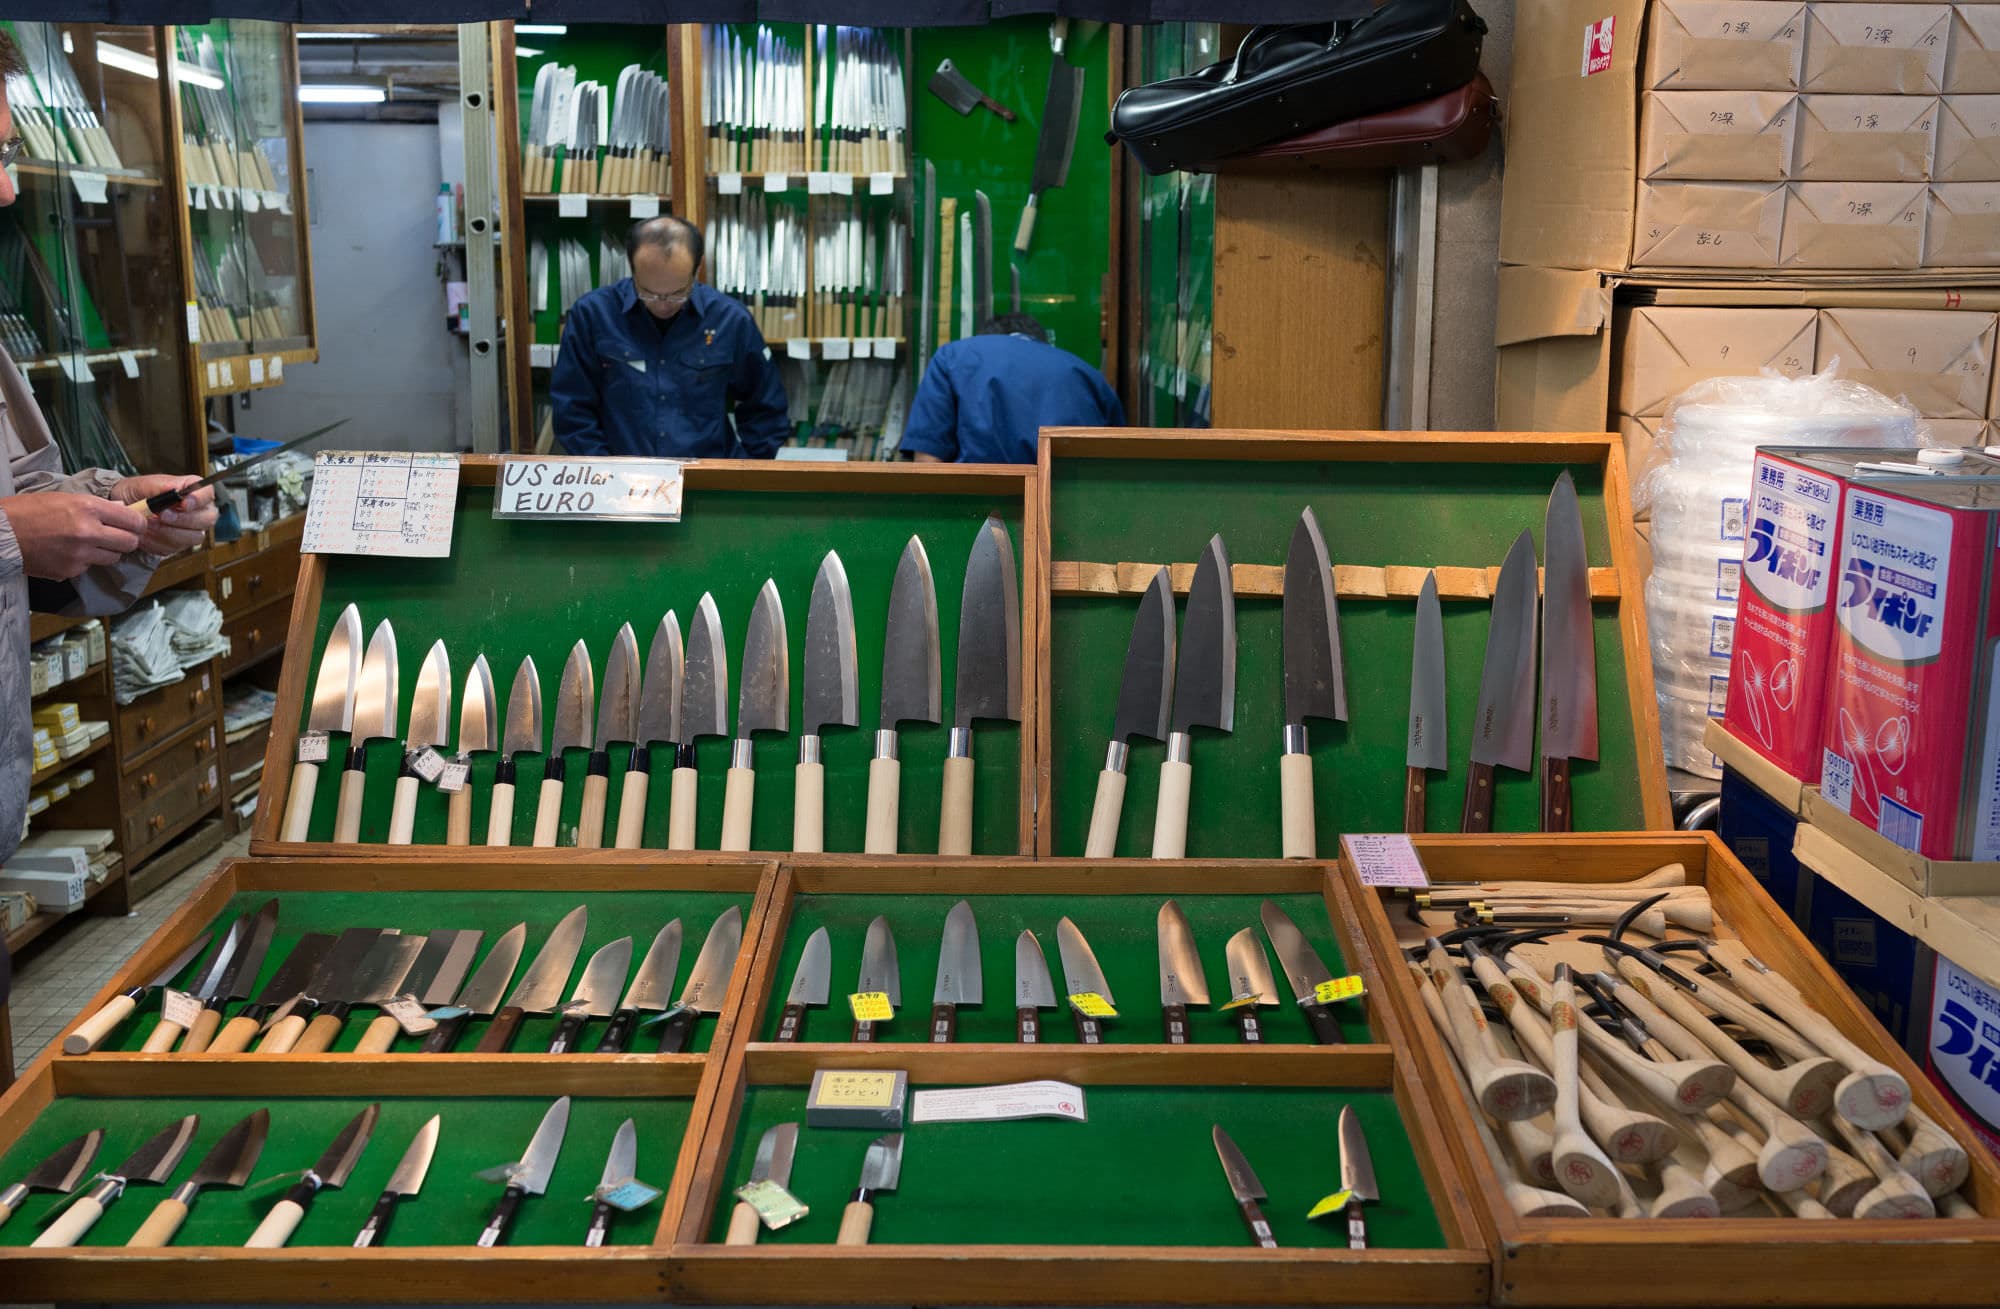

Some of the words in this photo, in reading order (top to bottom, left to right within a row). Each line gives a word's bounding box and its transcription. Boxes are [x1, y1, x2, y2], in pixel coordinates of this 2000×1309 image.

[1783, 27, 1795, 38] 15
[1924, 33, 1938, 46] 15
[1773, 118, 1786, 128] 15
[1920, 120, 1930, 131] 15
[1904, 211, 1916, 223] 15
[505, 464, 547, 486] US
[552, 465, 614, 486] dollar
[1760, 465, 1784, 488] 業務用
[515, 491, 595, 513] EURO
[1854, 499, 1884, 524] 業務用
[1841, 558, 1934, 638] ライポンF
